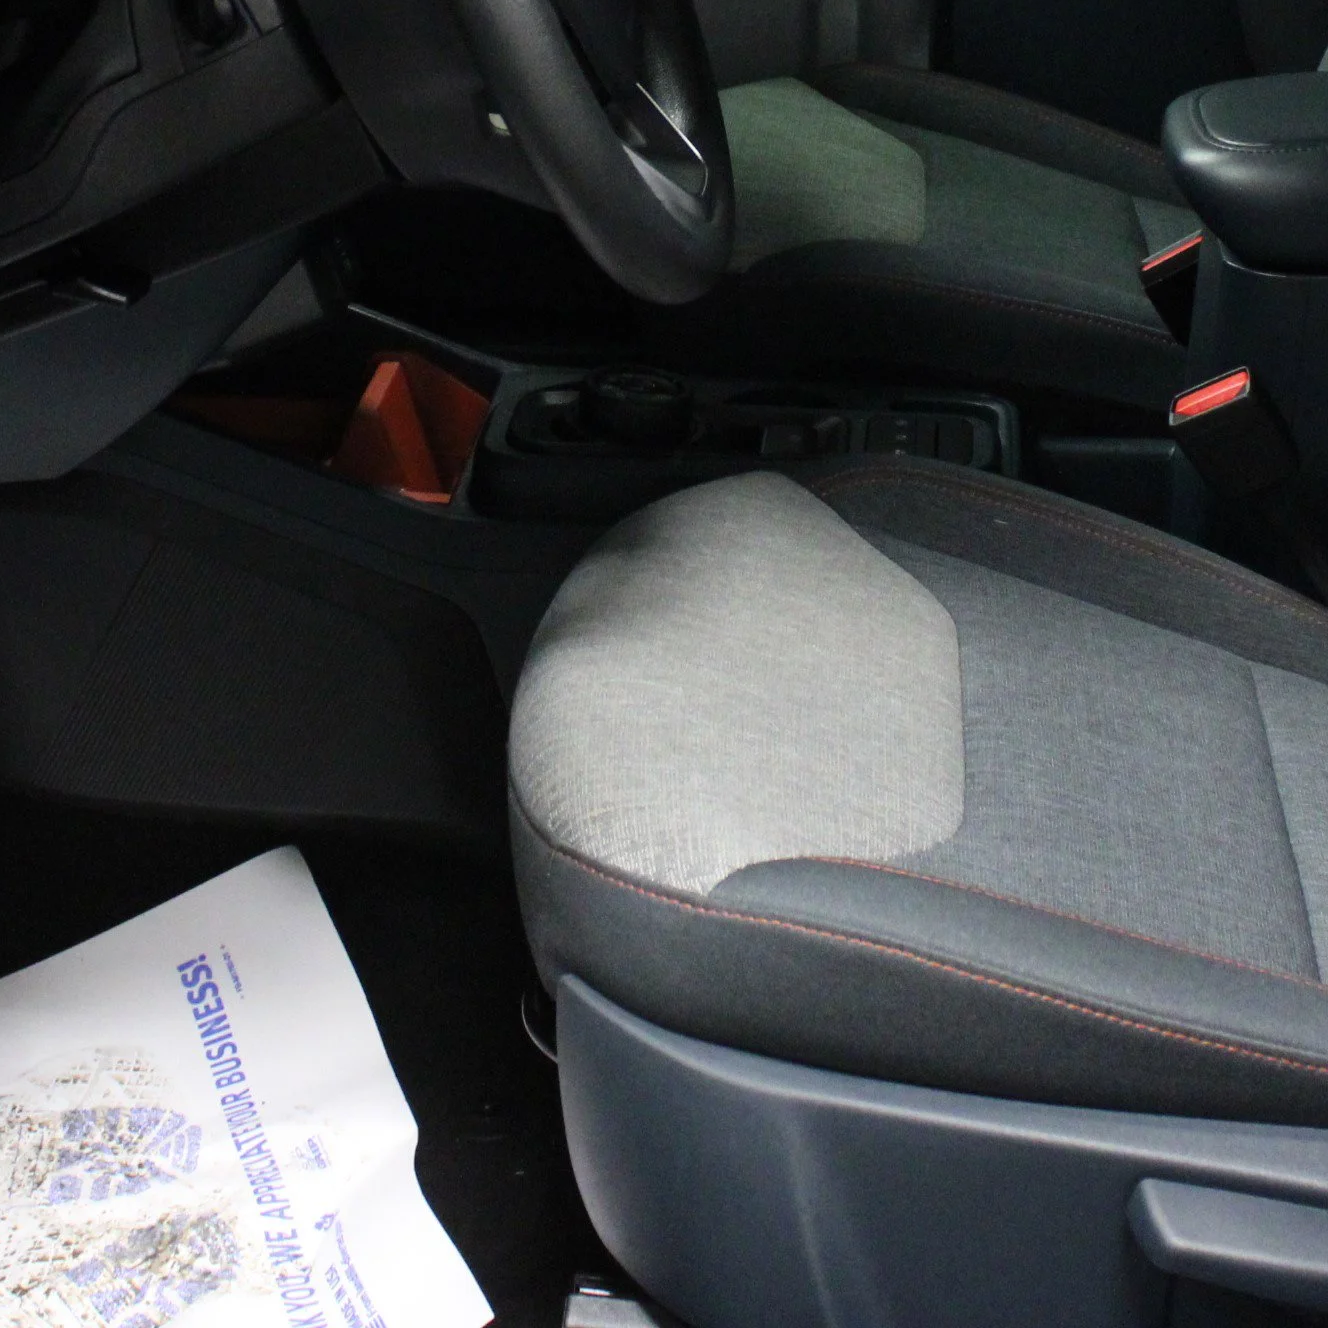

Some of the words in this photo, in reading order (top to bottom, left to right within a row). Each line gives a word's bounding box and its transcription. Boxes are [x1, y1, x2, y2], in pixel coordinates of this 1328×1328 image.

[176, 953, 247, 1089] BUSINESS!
[220, 1088, 262, 1131] YOUR
[231, 1122, 295, 1221] APPRECIATE
[264, 1228, 304, 1268] WE
